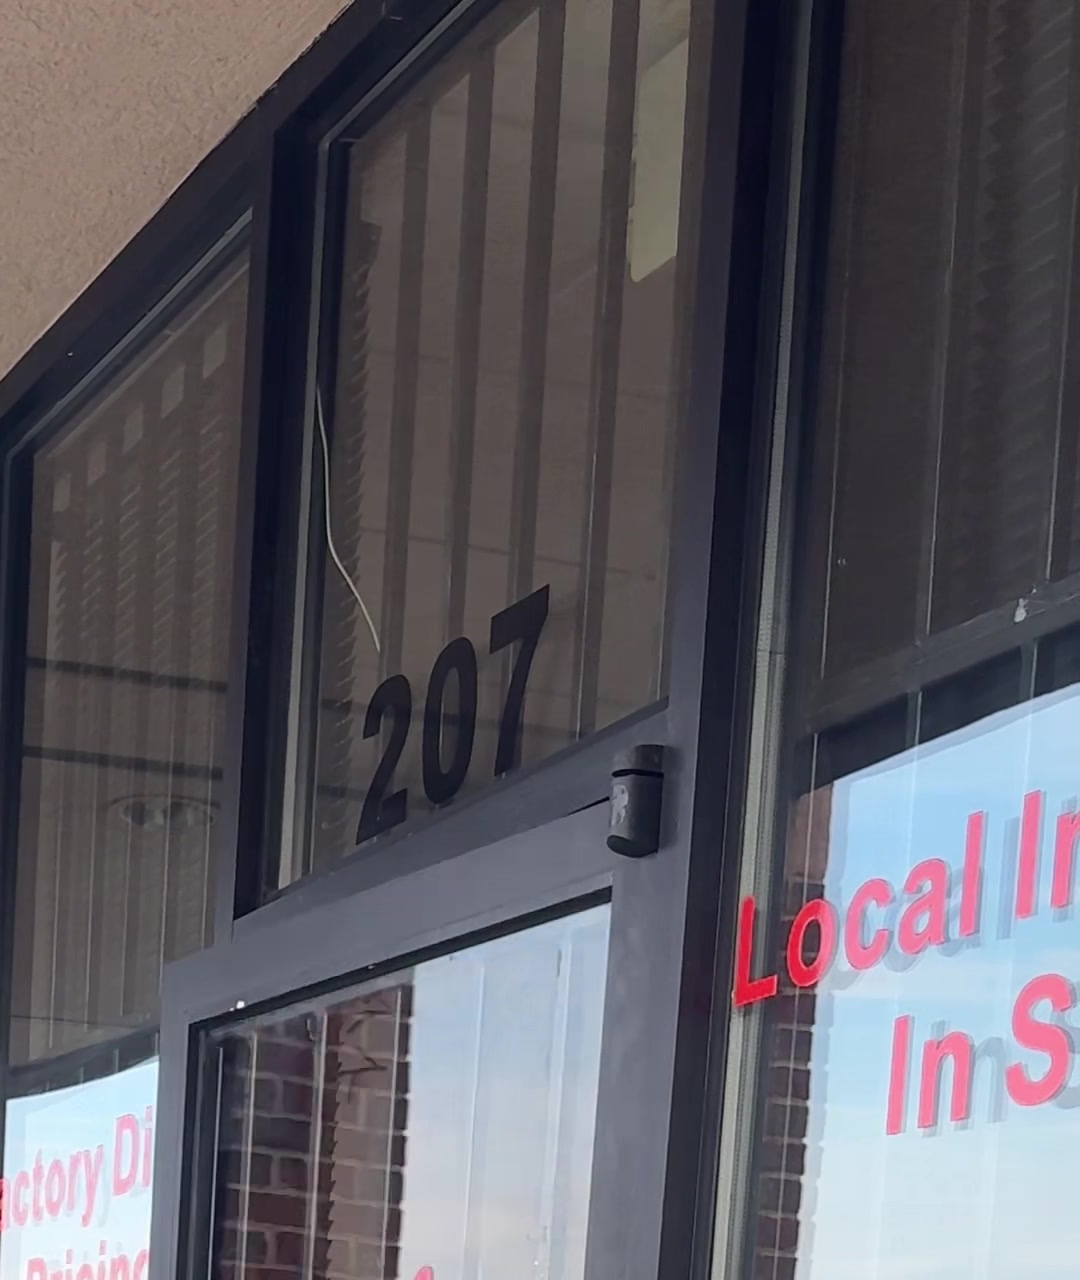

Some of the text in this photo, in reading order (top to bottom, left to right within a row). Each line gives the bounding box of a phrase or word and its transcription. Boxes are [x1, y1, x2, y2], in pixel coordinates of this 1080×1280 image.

[356, 584, 549, 846] 207
[733, 811, 983, 1008] Local
[886, 1015, 971, 1135] In
